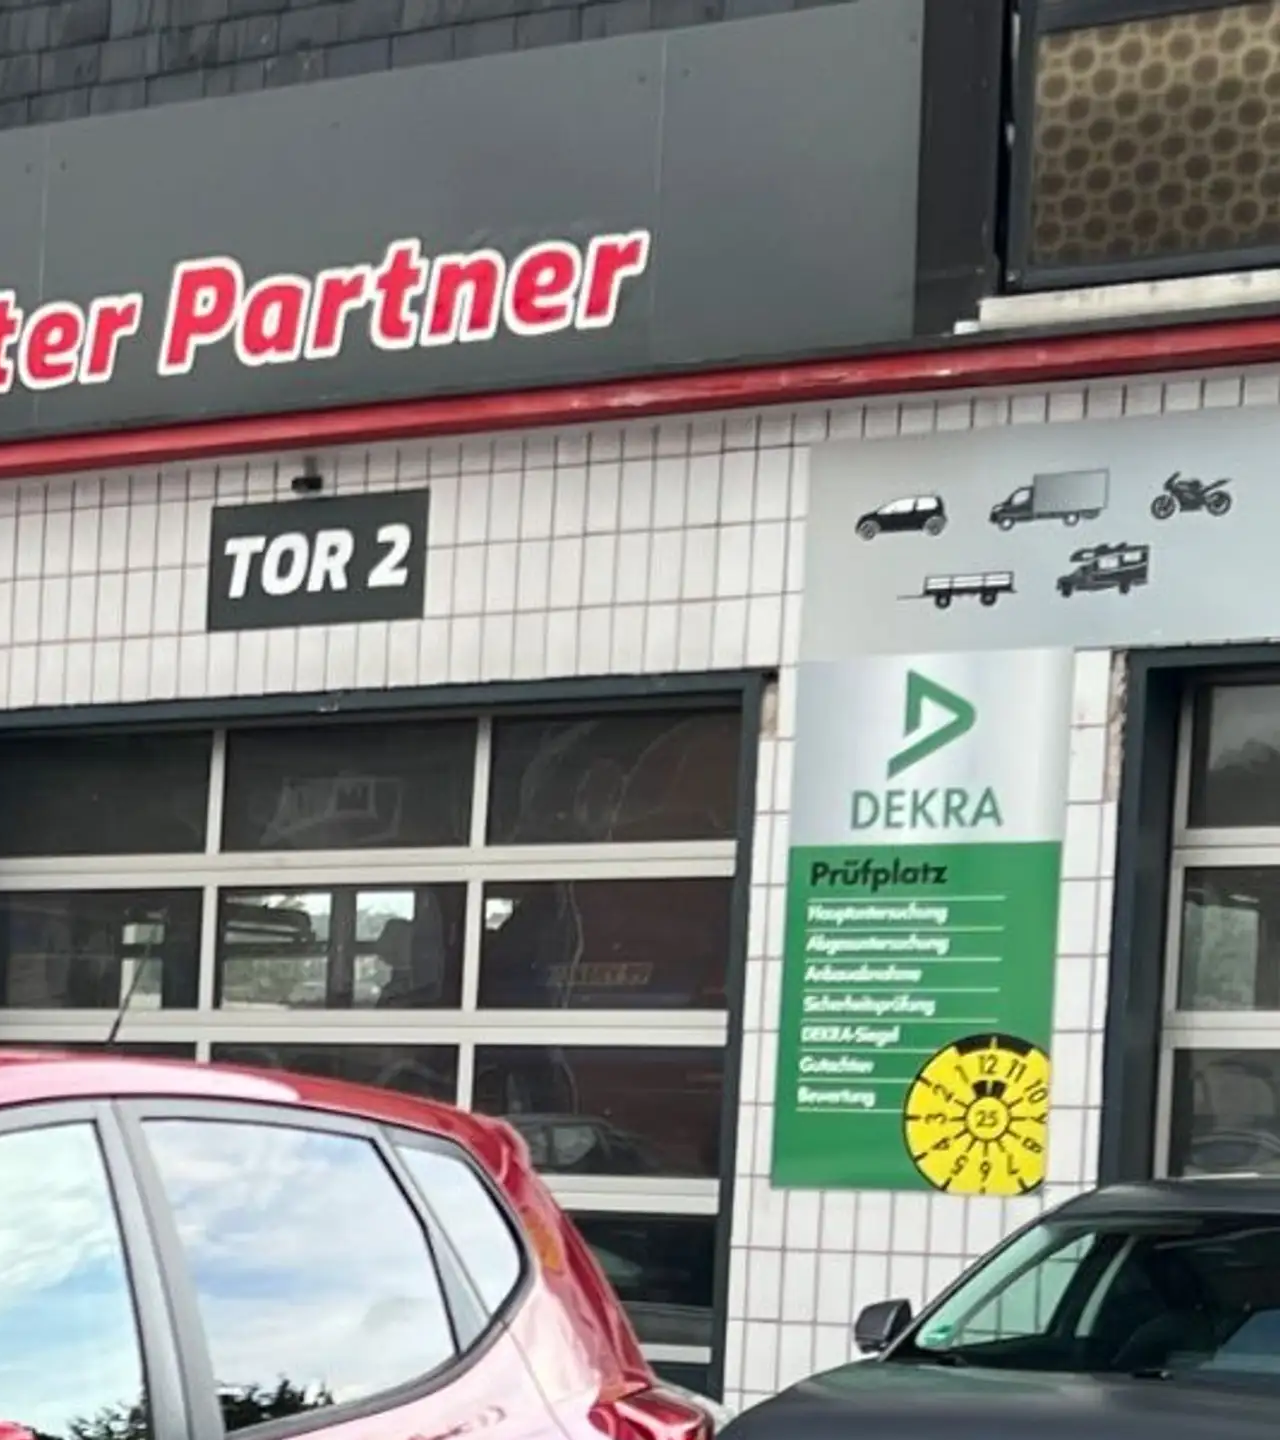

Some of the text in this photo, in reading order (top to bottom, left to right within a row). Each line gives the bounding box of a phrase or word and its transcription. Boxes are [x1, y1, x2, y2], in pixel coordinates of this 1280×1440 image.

[157, 230, 649, 375] Partner
[223, 523, 412, 600] TOR 2
[850, 786, 1004, 830] DEKRA
[810, 858, 948, 892] Prüfplatz
[978, 1054, 998, 1074] 12
[1006, 1059, 1027, 1083] 11
[932, 1083, 954, 1102] 2
[1024, 1080, 1048, 1105] 10
[925, 1112, 947, 1125] 3
[975, 1110, 998, 1128] 25
[950, 1154, 969, 1176] 5
